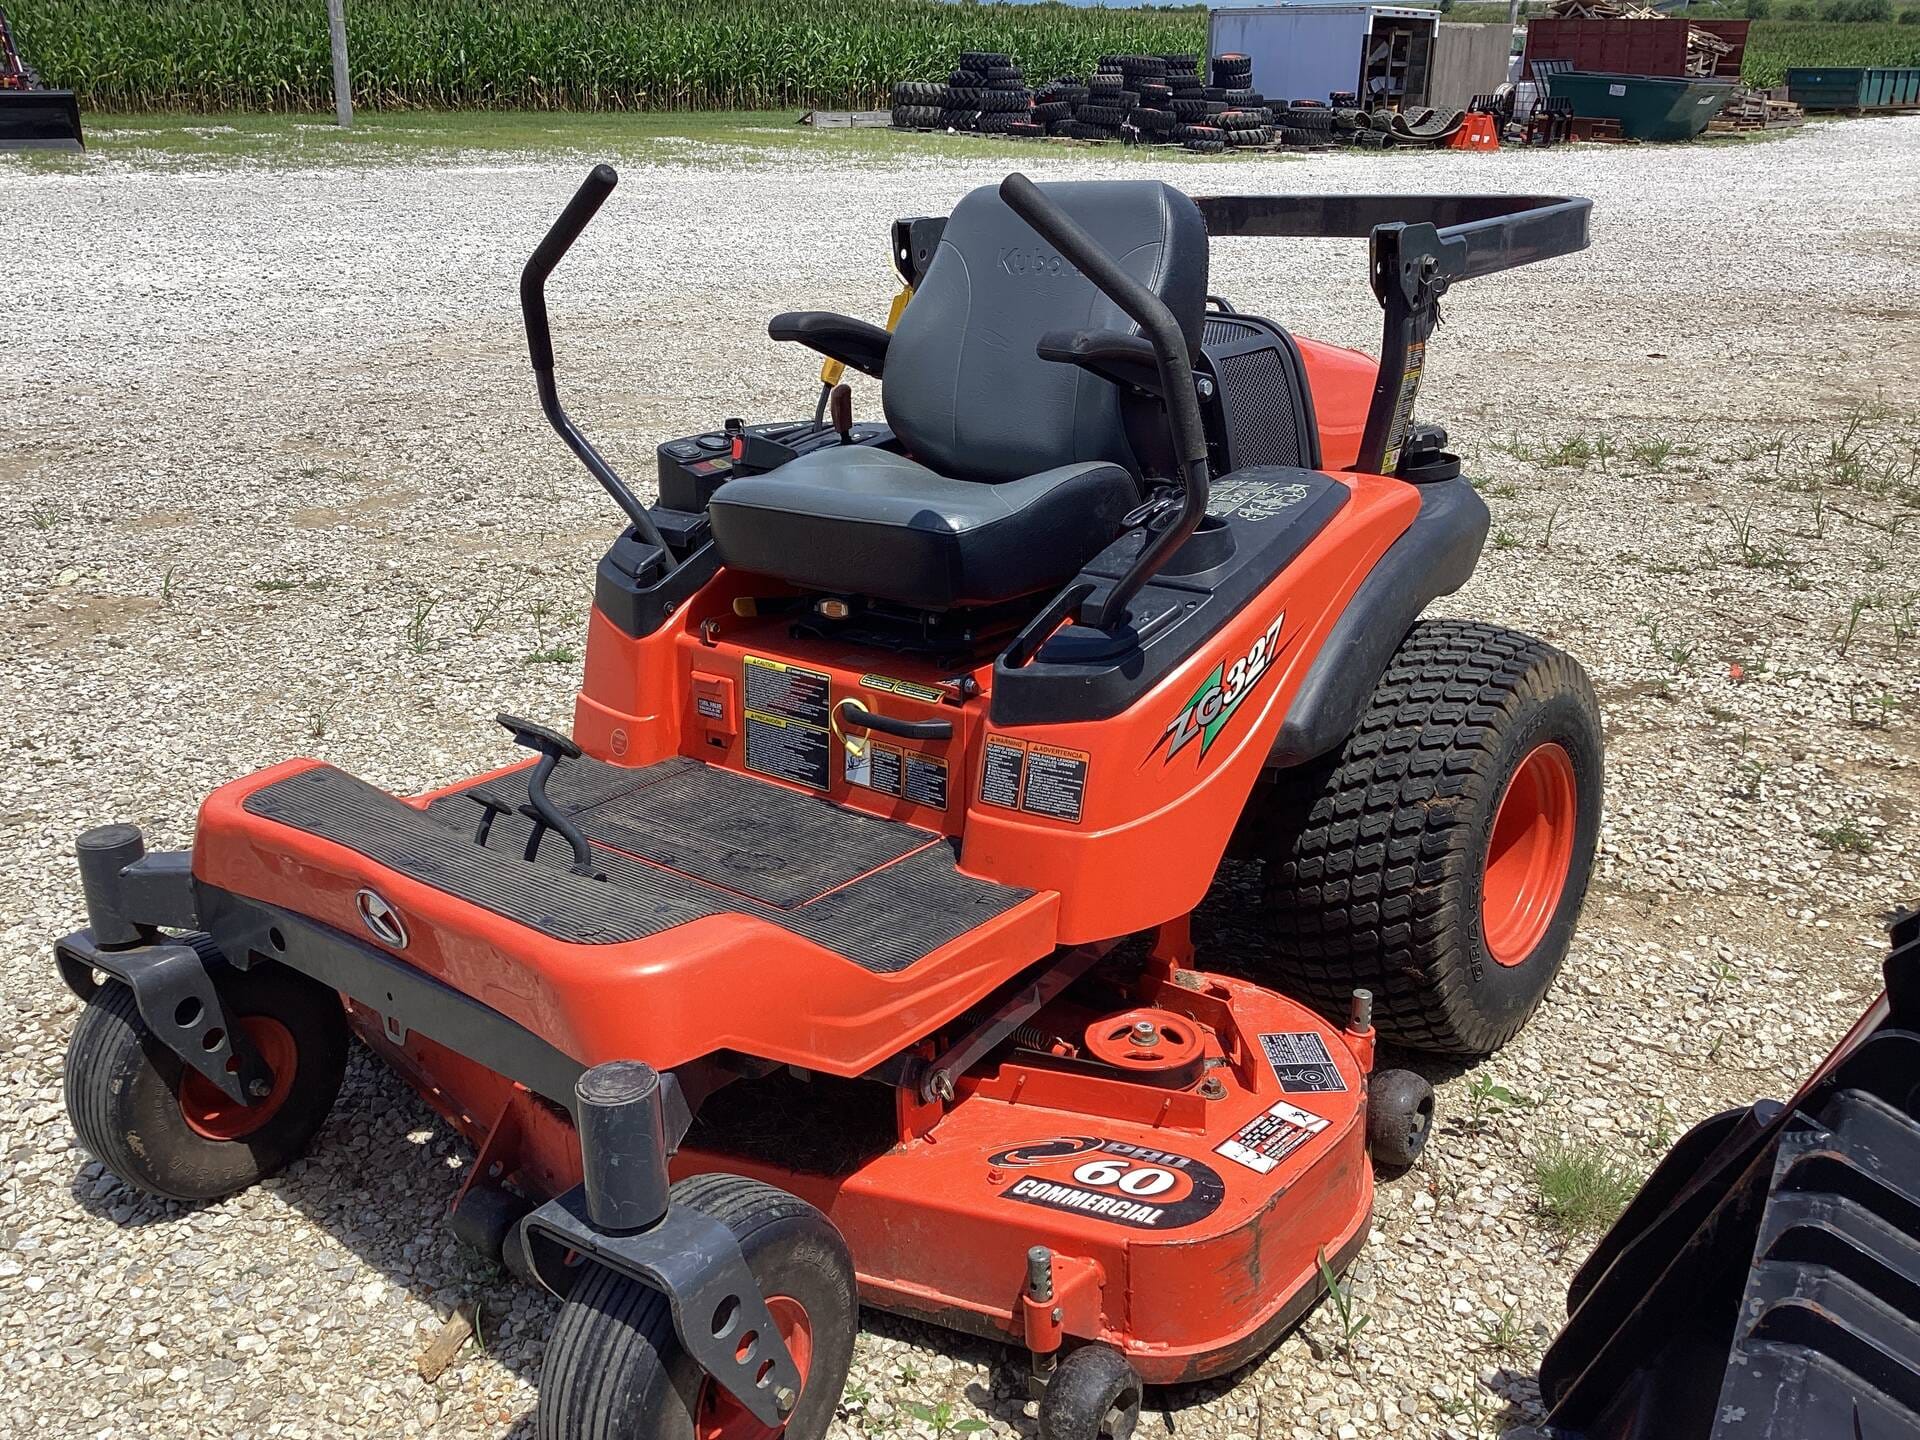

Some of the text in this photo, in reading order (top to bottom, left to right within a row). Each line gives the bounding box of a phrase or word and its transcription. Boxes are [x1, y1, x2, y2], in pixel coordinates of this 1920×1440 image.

[998, 247, 1082, 276] Kubo
[1166, 610, 1286, 760] ZG327
[995, 736, 1023, 748] WARNING
[1038, 746, 1083, 759] ADVERTENCIA
[1102, 1141, 1192, 1168] PRO
[1073, 1160, 1175, 1196] 60
[1012, 1179, 1165, 1226] COMMERCIAL
